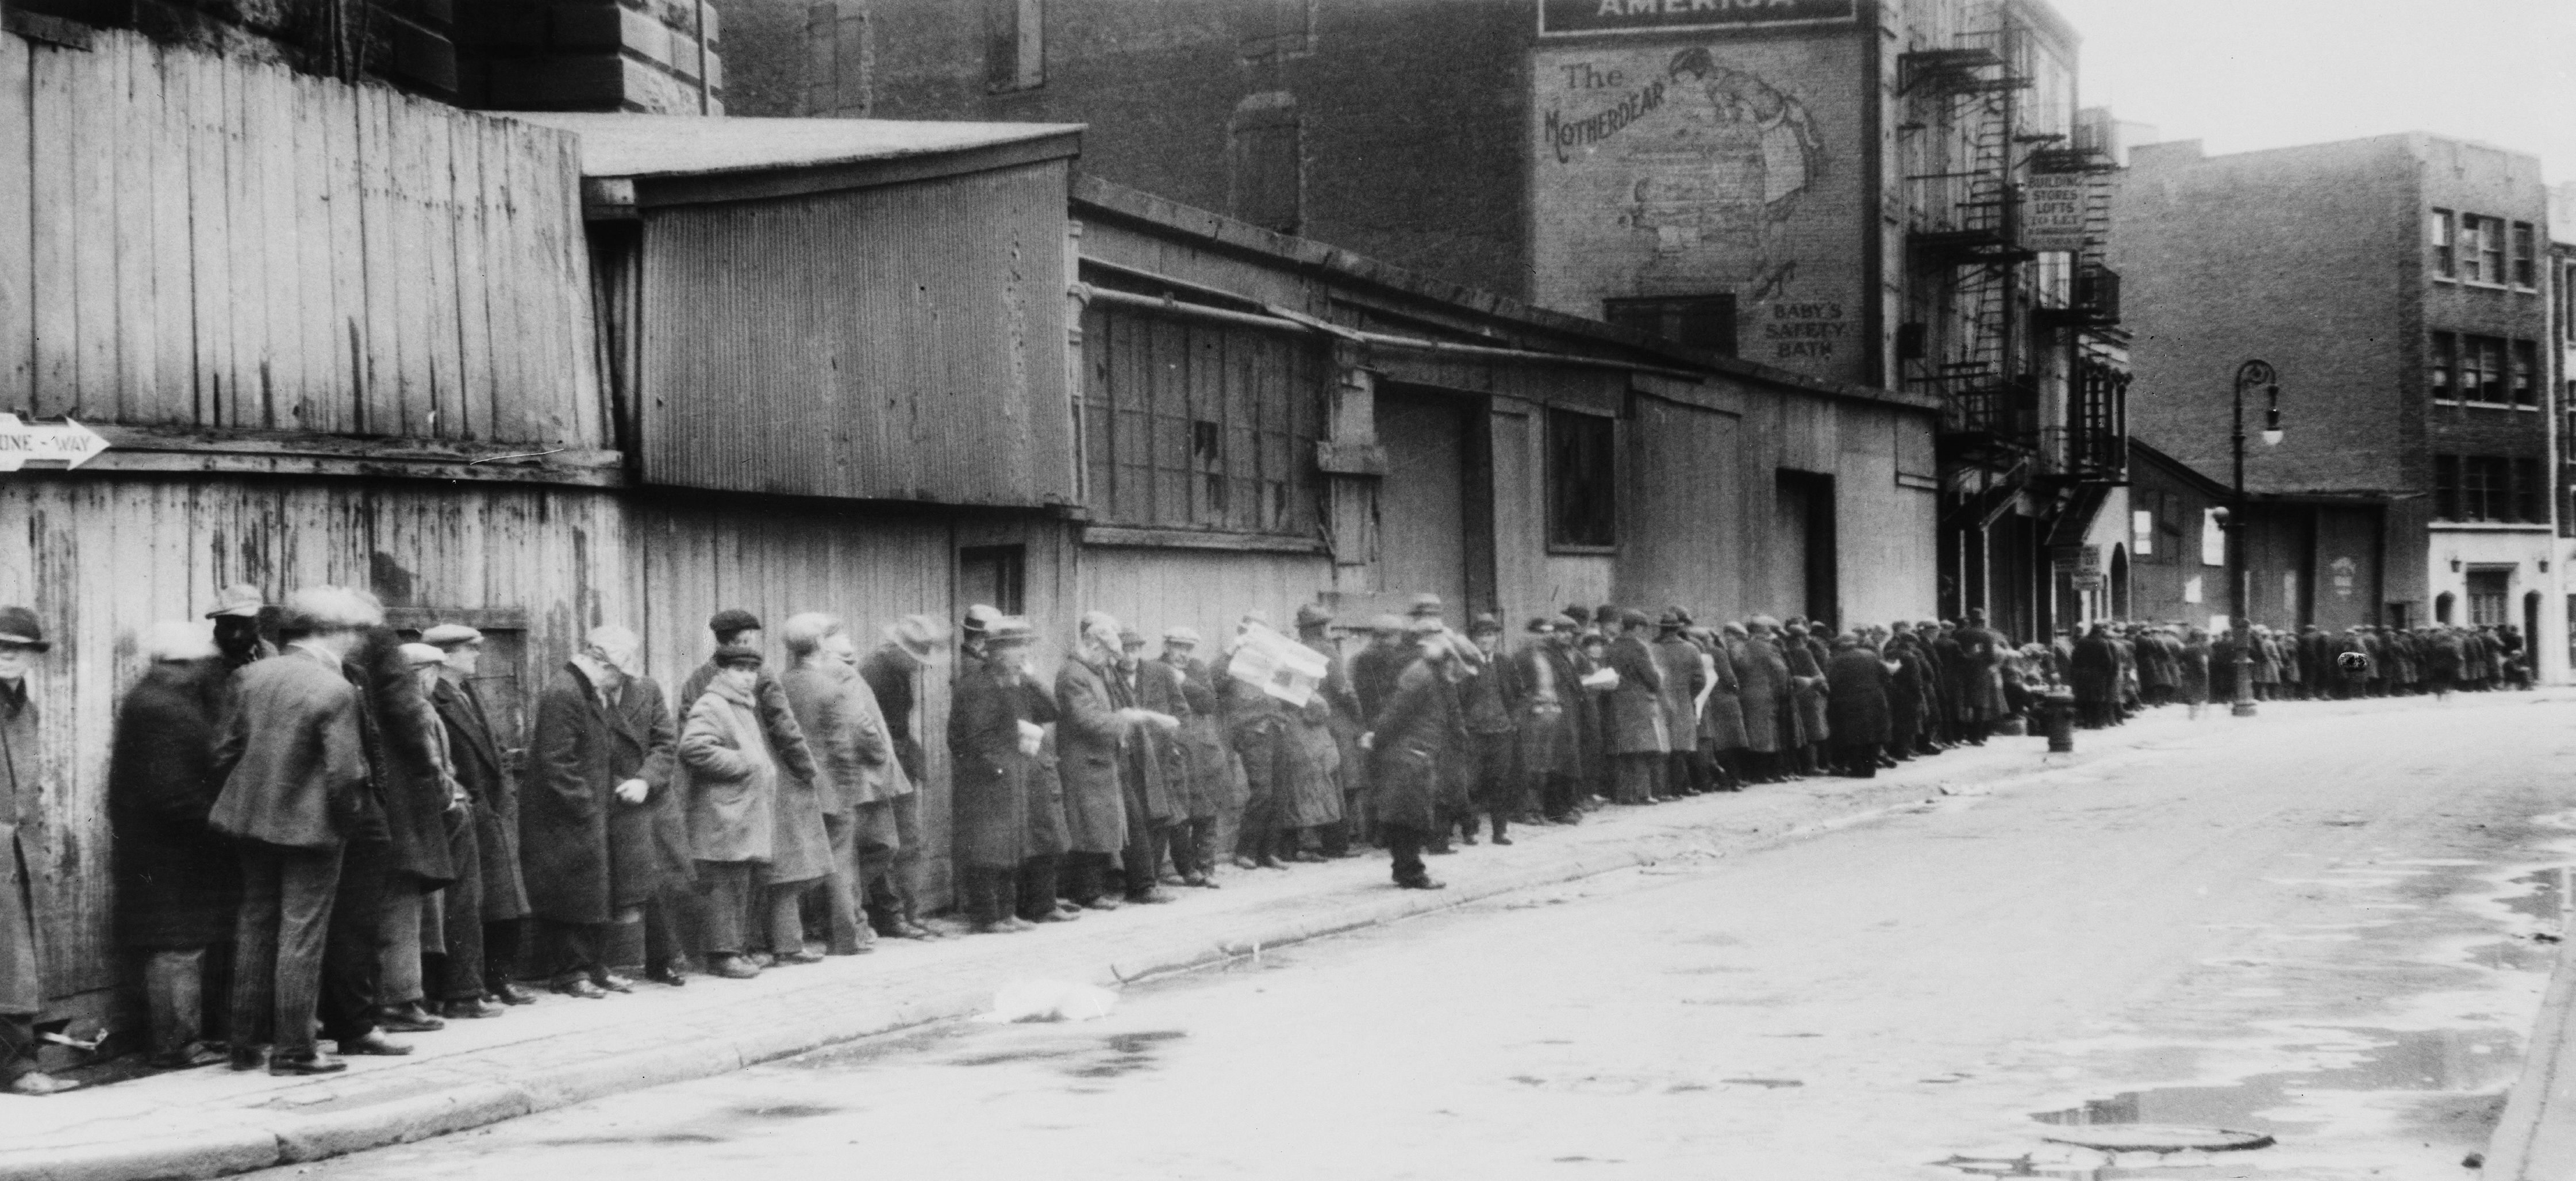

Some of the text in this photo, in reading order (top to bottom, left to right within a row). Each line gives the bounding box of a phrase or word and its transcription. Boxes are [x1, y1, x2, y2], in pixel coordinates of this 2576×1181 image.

[1560, 62, 1624, 89] The
[1545, 80, 1665, 163] MOTHERDEAR
[2033, 190, 2078, 201] STORES
[2036, 202, 2075, 214] LOFTS
[2030, 215, 2081, 225] TO LET
[1774, 302, 1843, 319] BABY'S
[1765, 322, 1846, 339] SAFETY
[1777, 340, 1832, 358] BATH
